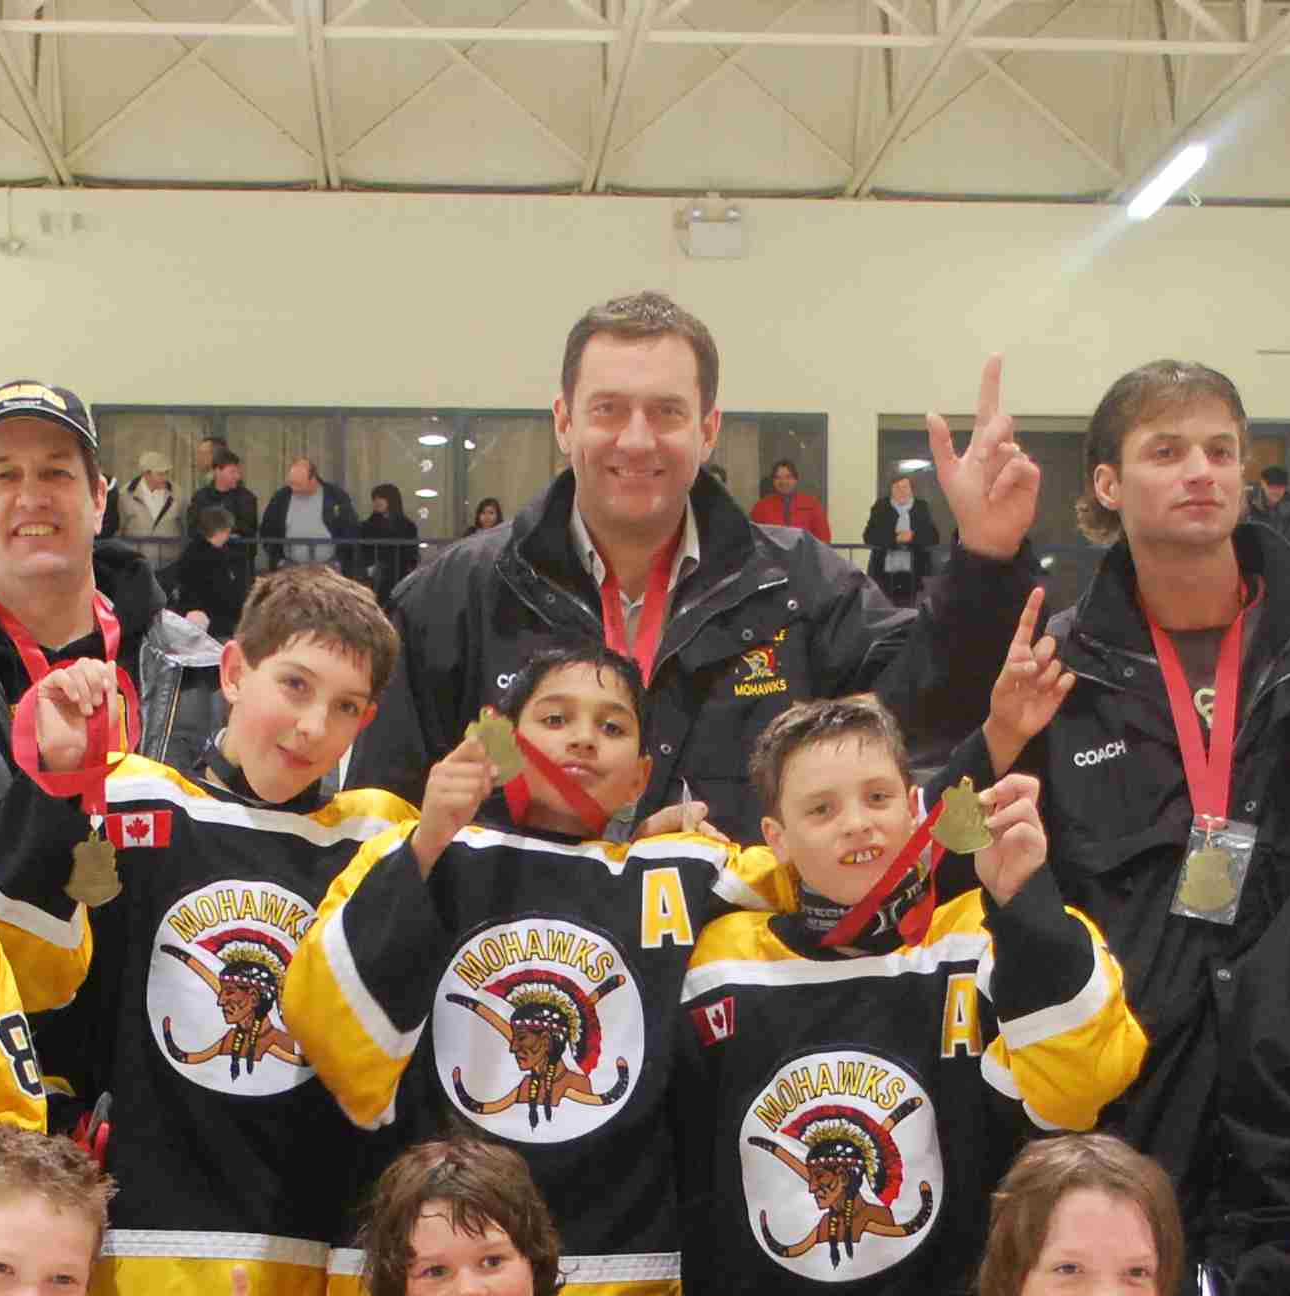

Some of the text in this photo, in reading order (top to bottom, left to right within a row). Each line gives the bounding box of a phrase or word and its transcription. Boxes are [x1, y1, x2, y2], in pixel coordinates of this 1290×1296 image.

[734, 679, 787, 696] MOHAWKS
[1073, 739, 1127, 768] COACH
[168, 889, 319, 944] MOHAWK
[641, 867, 694, 949] A
[453, 929, 614, 991] MOHAWKS
[940, 974, 982, 1058] A
[756, 1062, 905, 1134] MOHAWKS
